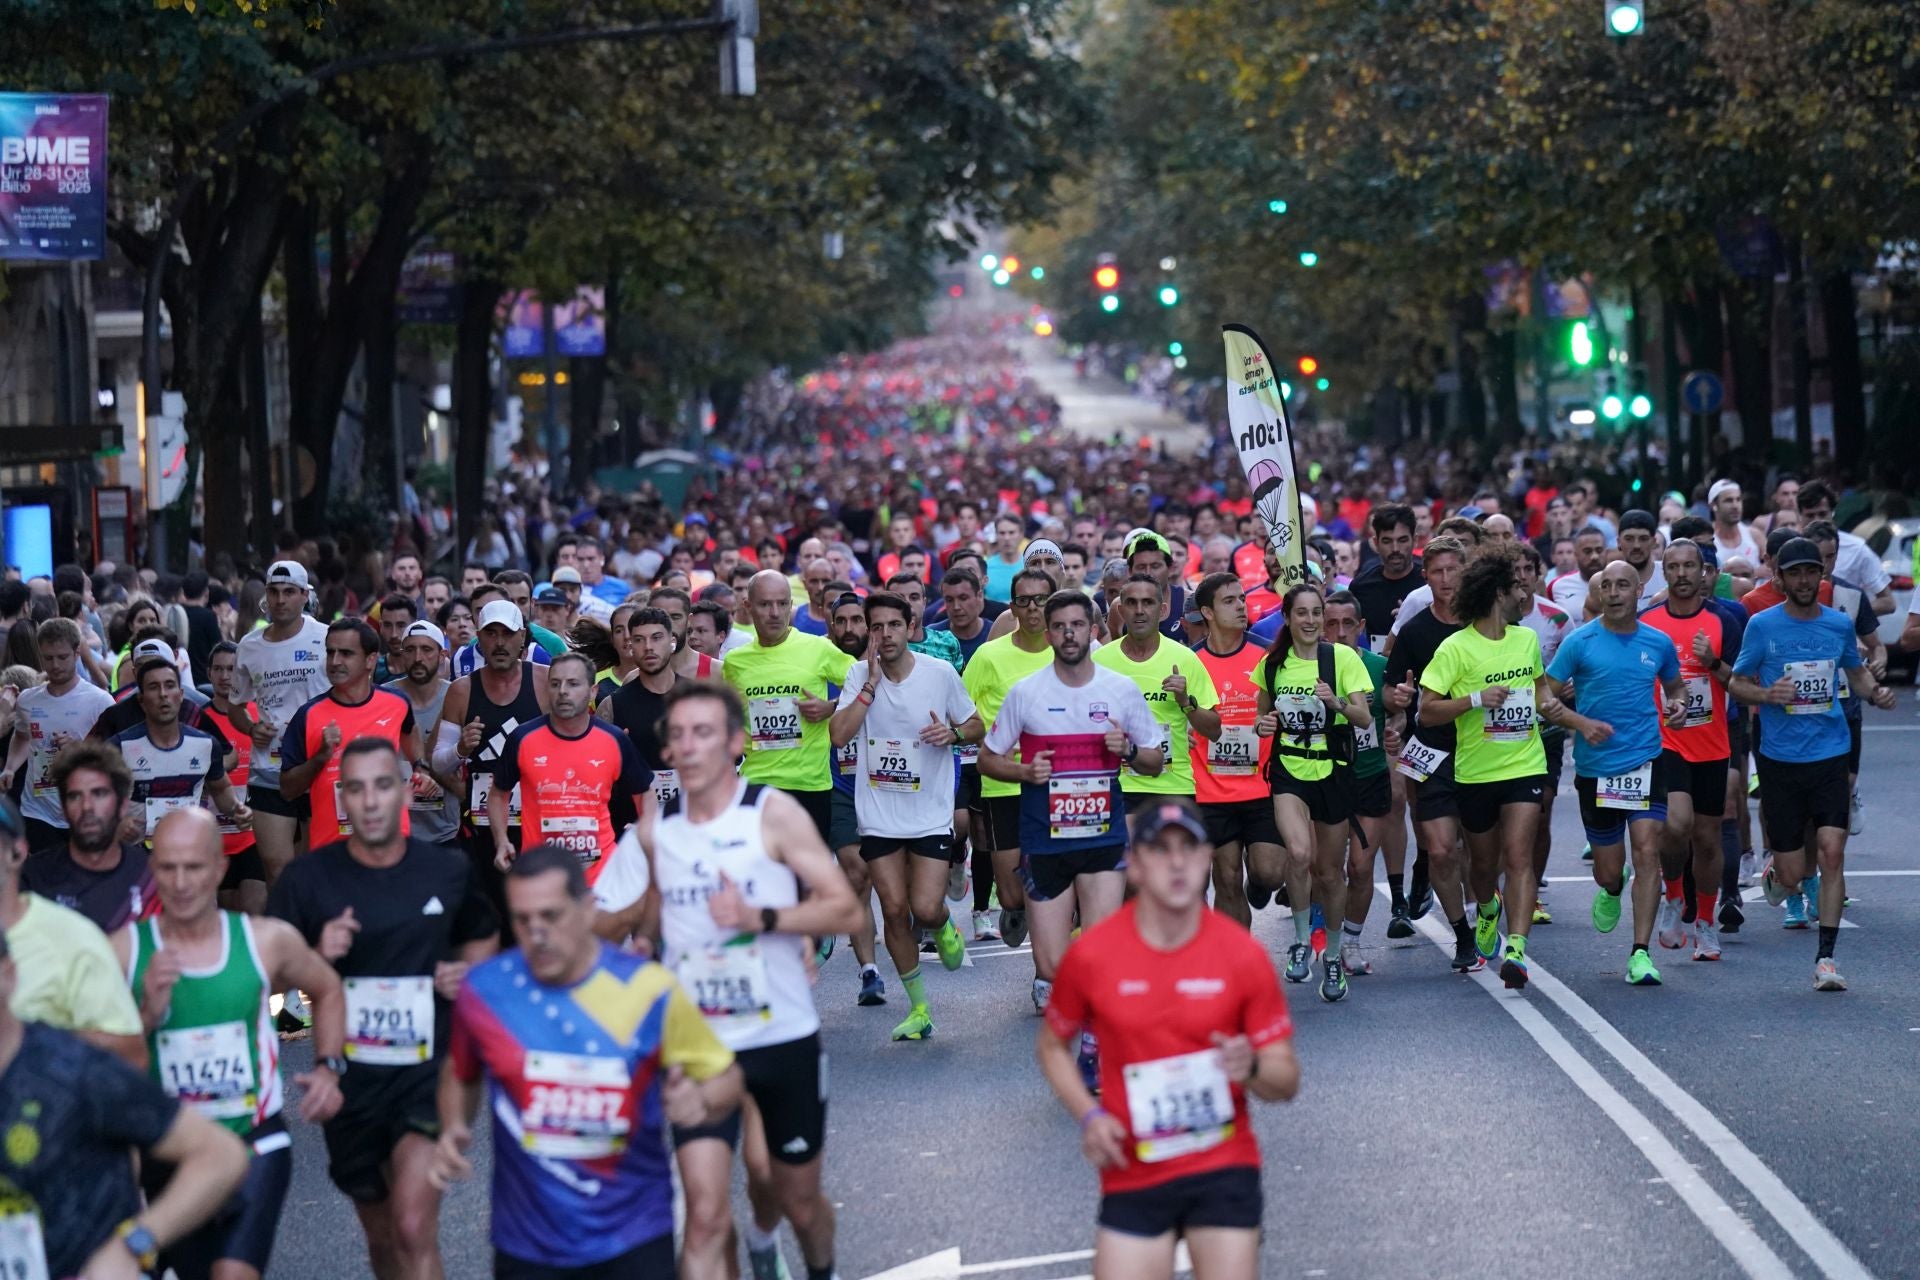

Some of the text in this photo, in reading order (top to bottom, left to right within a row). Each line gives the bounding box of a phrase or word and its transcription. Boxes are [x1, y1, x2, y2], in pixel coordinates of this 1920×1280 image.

[2, 136, 90, 165] BIME
[1, 166, 22, 181] Urr
[64, 165, 90, 181] Oct
[58, 181, 91, 194] 2025
[264, 667, 316, 680] fuencampo
[1485, 666, 1533, 684] GOLDCAR
[745, 685, 800, 697] GOLDCAR
[1794, 678, 1827, 693] 2832
[1281, 710, 1323, 724] 1204
[1488, 706, 1532, 721] 12093
[754, 714, 798, 729] 12092
[1215, 742, 1249, 755] 3021
[1407, 744, 1436, 763] 3199
[880, 757, 907, 771] 793
[1605, 777, 1642, 790] 3189
[1054, 797, 1107, 815] 20939
[546, 835, 597, 851] 20380
[359, 1007, 413, 1029] 3901
